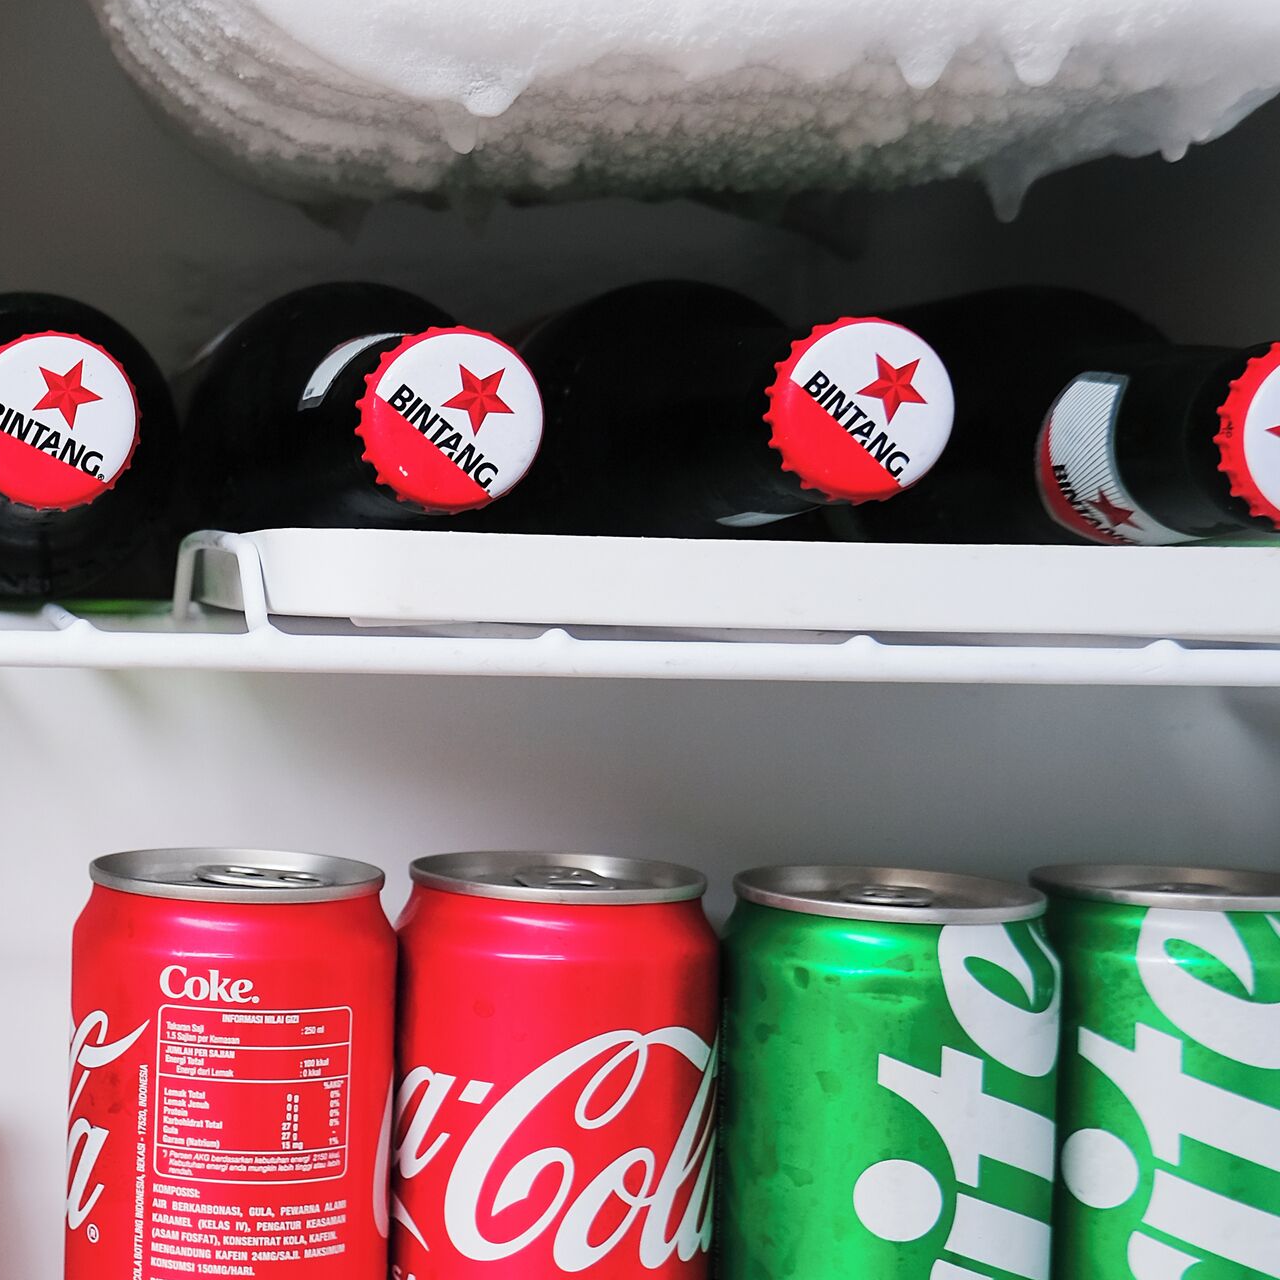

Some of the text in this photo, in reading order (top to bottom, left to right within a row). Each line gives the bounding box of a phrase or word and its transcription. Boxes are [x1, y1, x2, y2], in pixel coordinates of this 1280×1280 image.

[387, 383, 497, 491] BINTANG
[802, 370, 909, 481] BINTANG
[152, 1198, 167, 1209] AIR
[216, 1250, 248, 1261] KAFEIN
